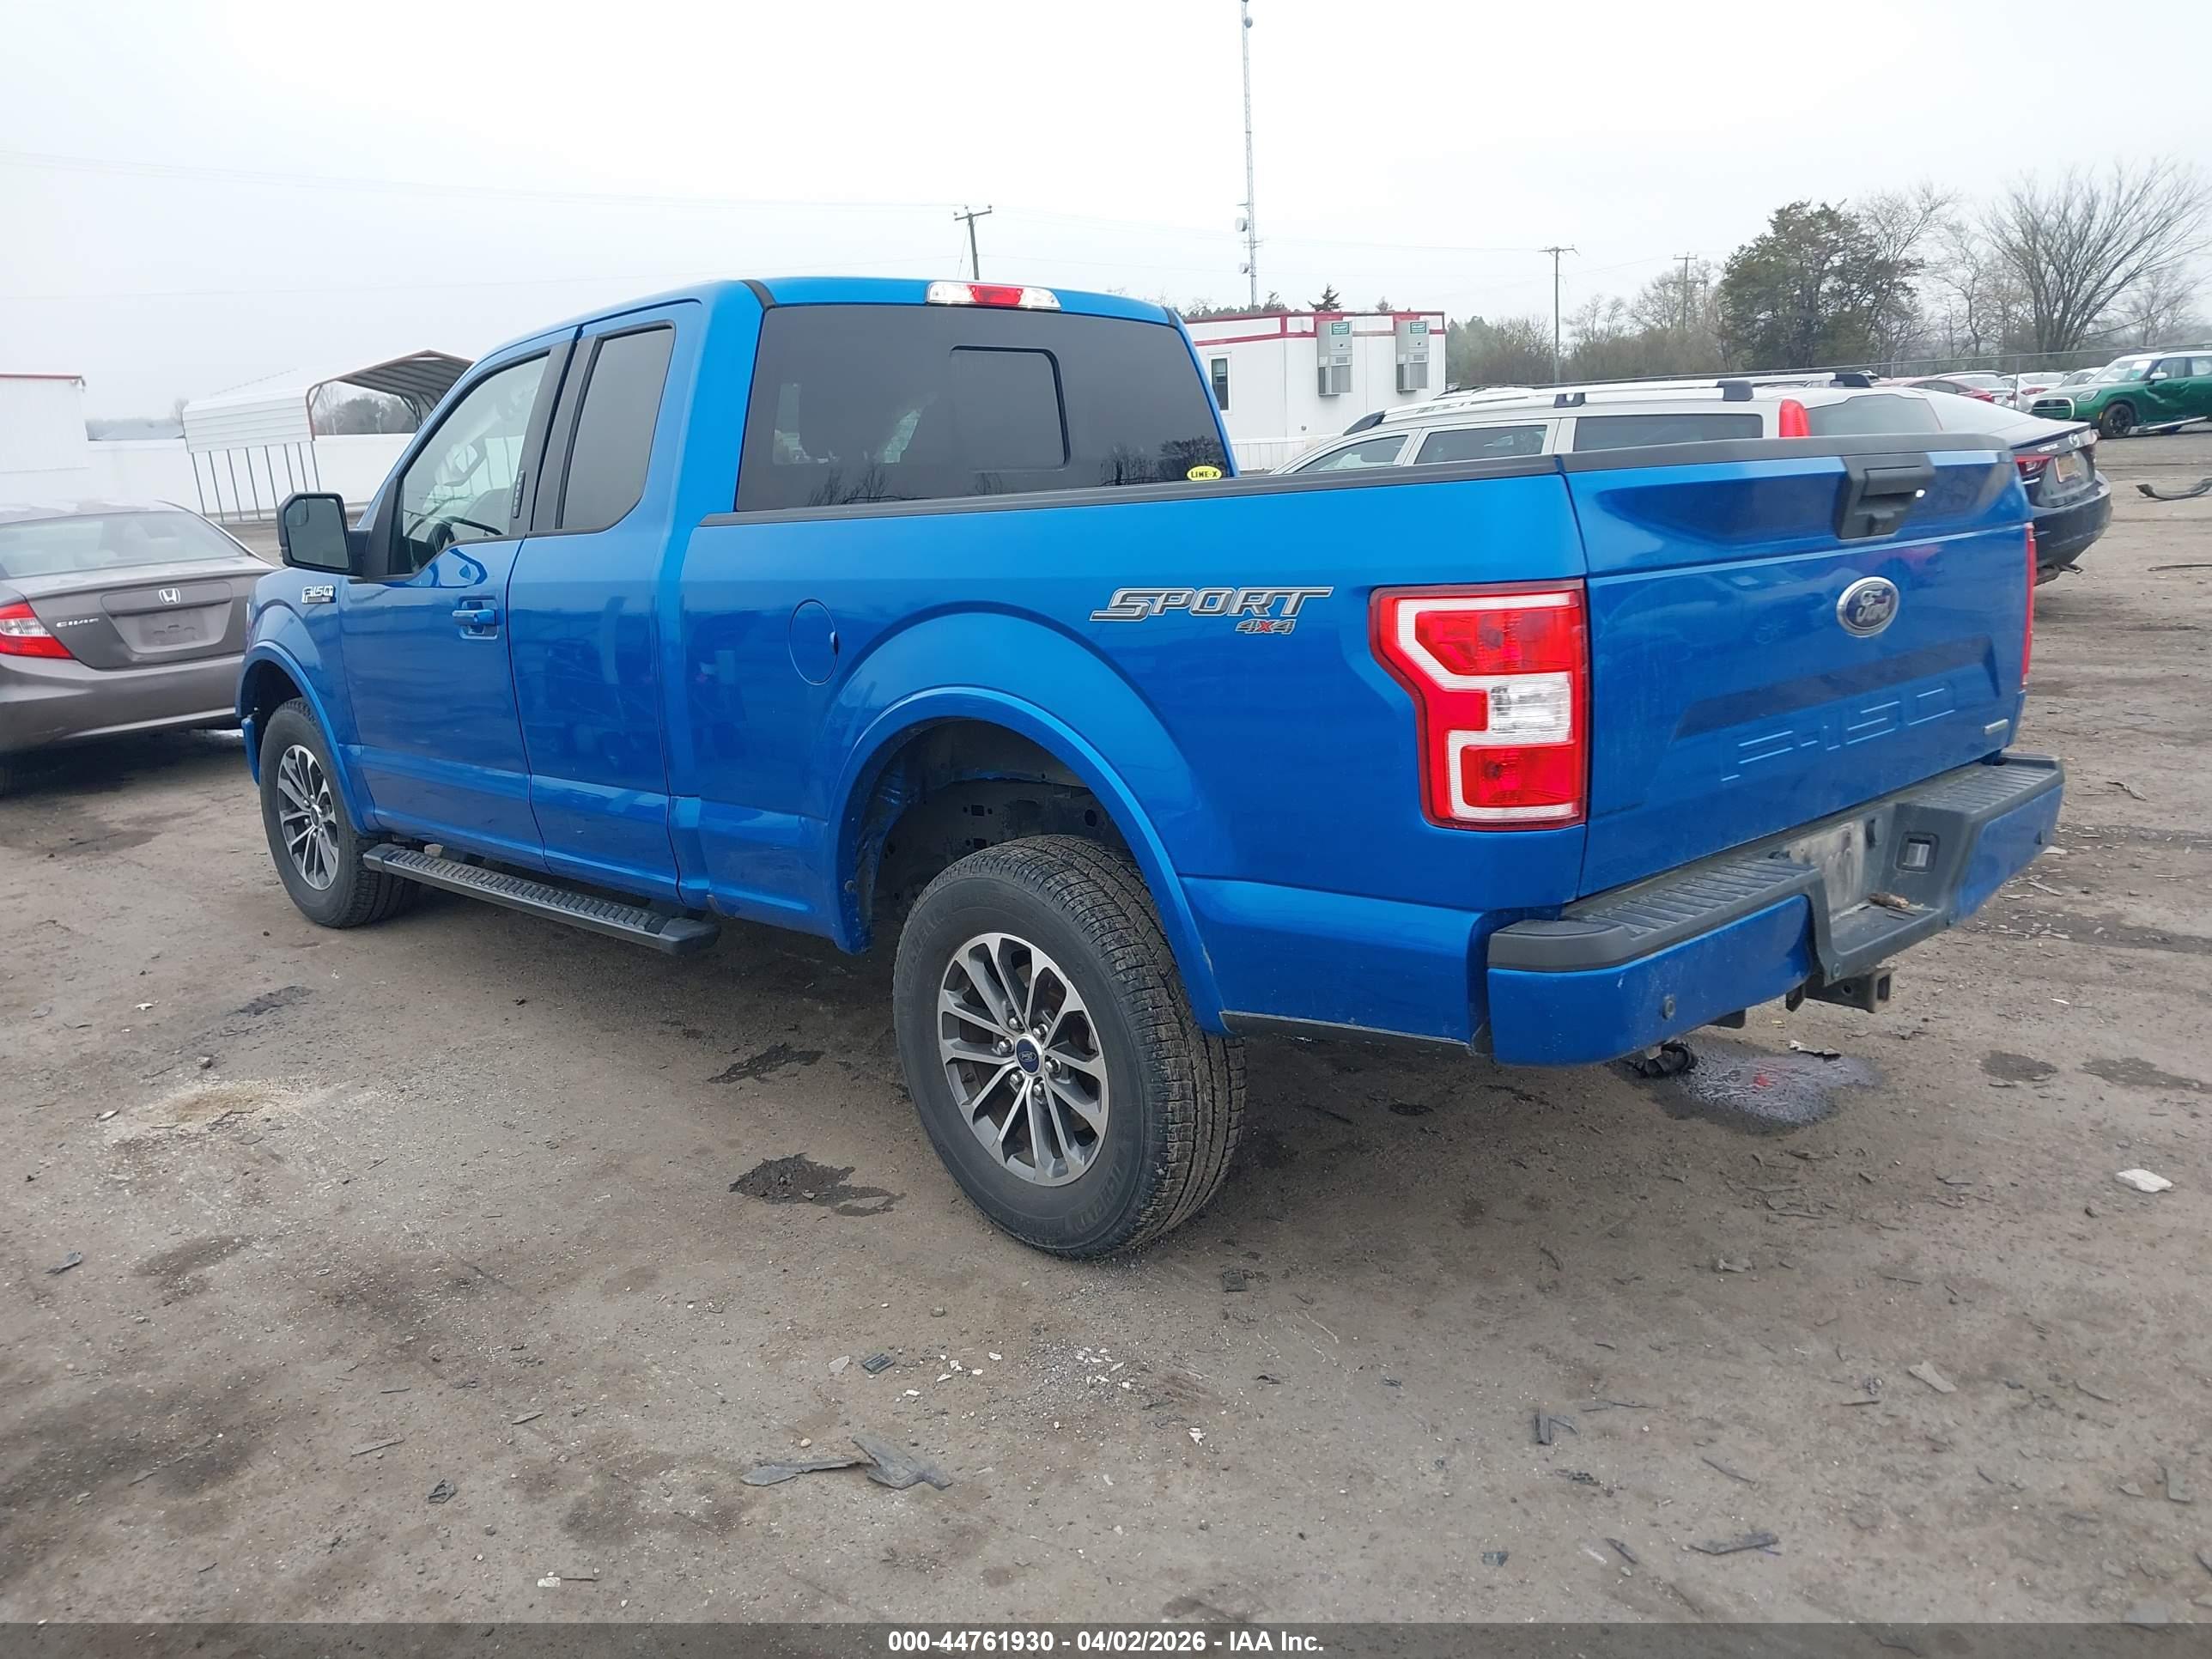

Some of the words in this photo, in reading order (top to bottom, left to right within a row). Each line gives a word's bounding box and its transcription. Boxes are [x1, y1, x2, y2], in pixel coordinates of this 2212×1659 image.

[1190, 470, 1218, 478] LINE-X
[1090, 586, 1334, 623] SPORT
[1855, 589, 1890, 623] Ford
[1720, 681, 1956, 781] F-150
